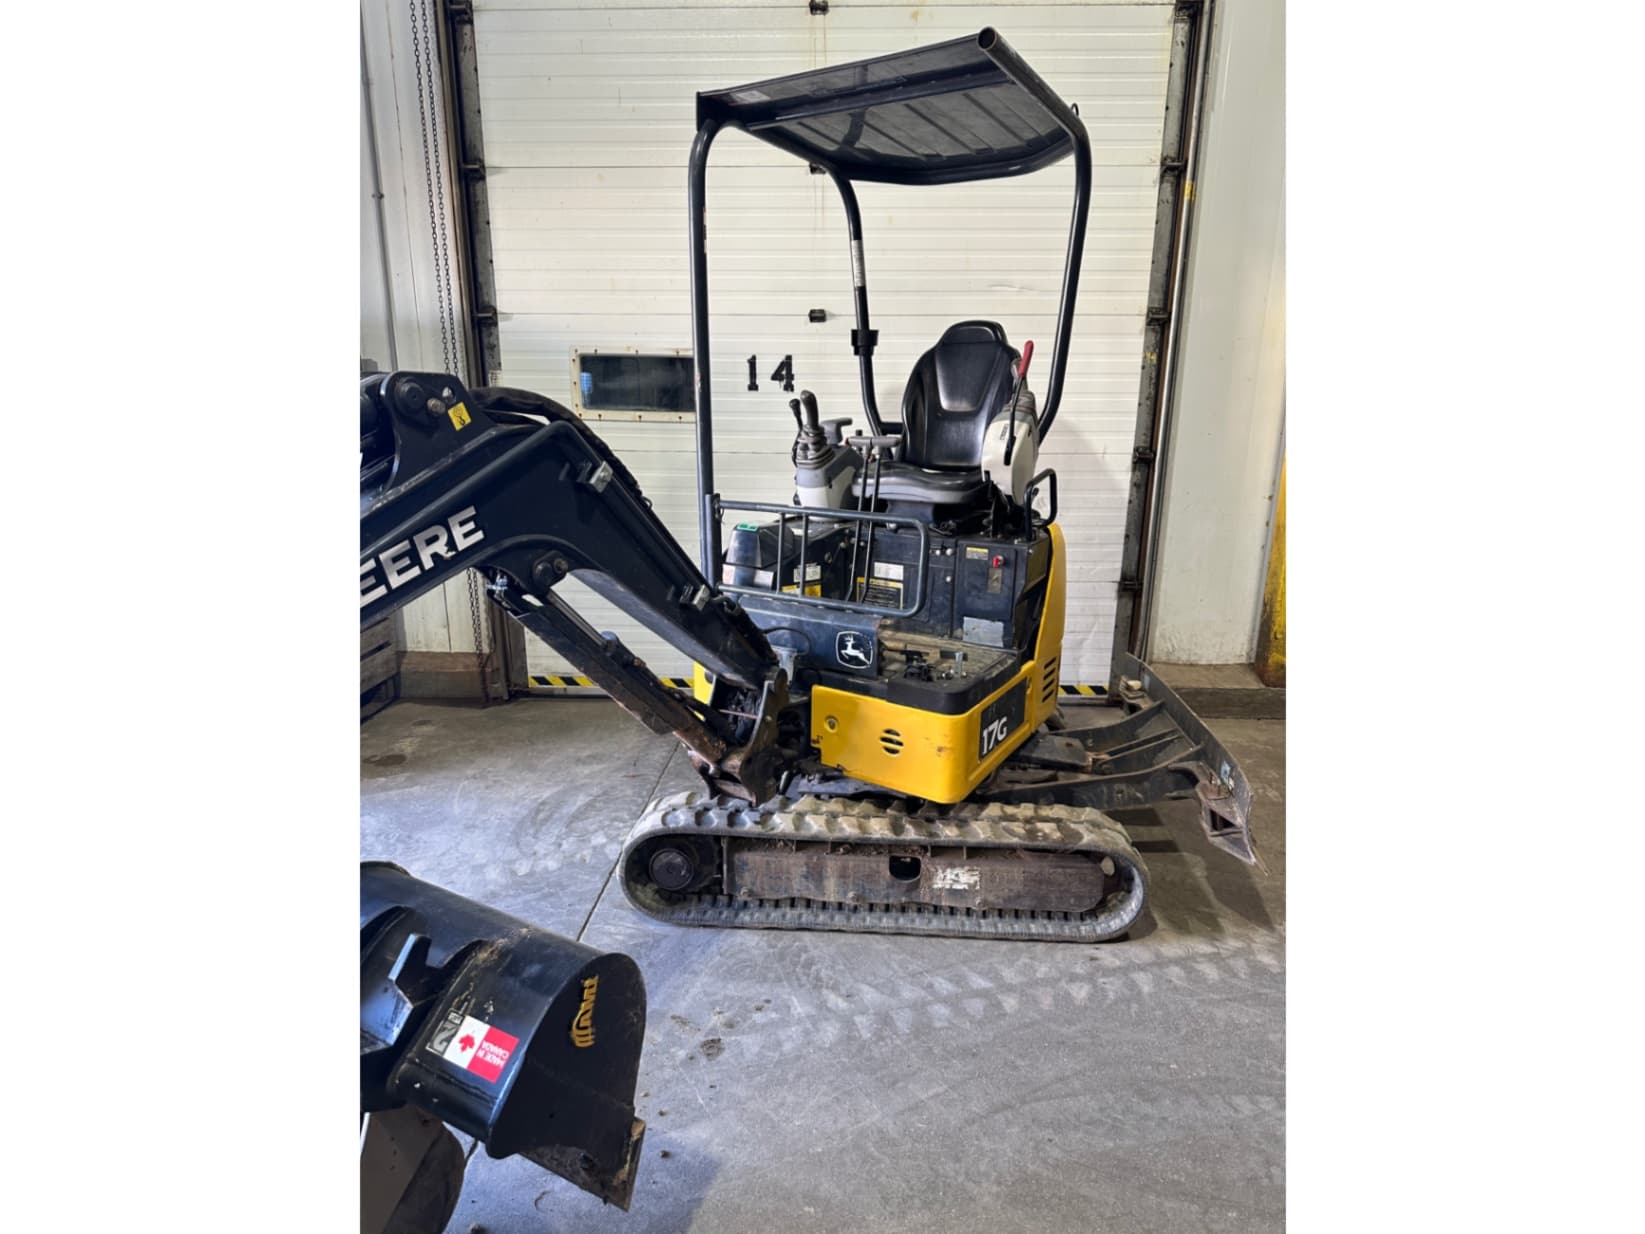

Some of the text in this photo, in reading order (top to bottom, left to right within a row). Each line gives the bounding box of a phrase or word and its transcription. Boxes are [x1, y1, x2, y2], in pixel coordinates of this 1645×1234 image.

[747, 354, 795, 393] 14
[983, 715, 1008, 755] 17G
[480, 1040, 510, 1060] CANADA
[484, 1052, 506, 1068] MADE
